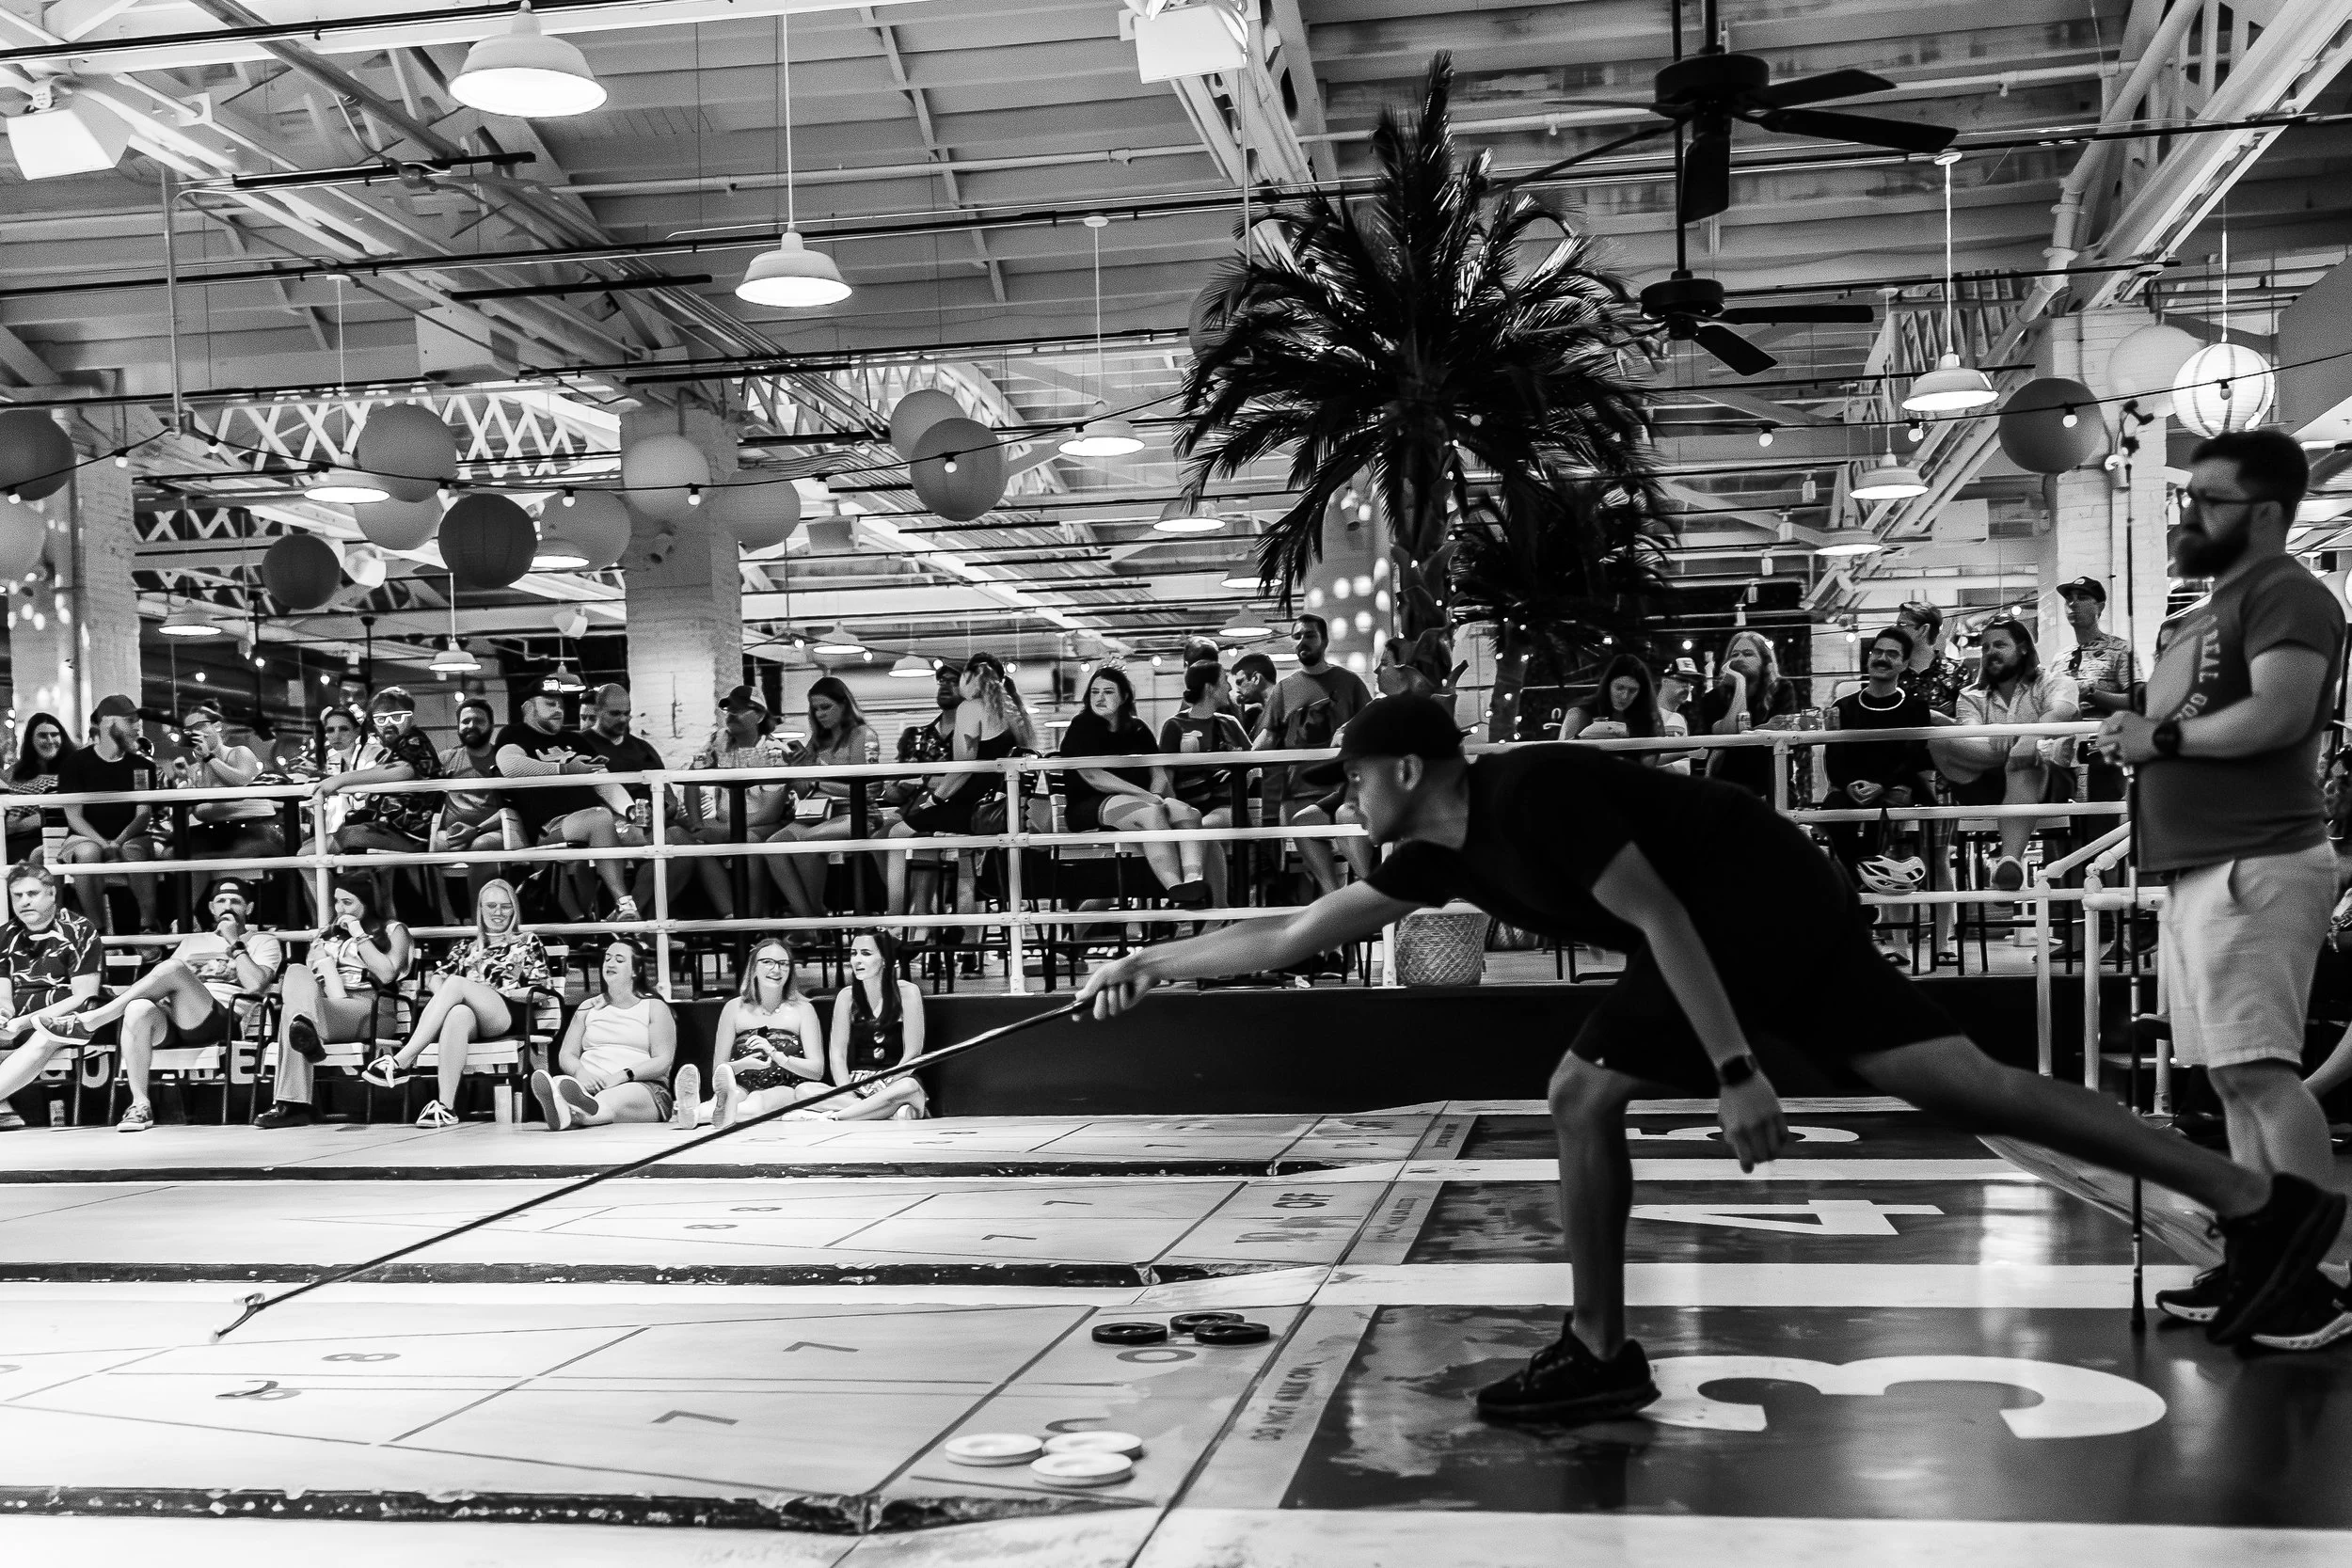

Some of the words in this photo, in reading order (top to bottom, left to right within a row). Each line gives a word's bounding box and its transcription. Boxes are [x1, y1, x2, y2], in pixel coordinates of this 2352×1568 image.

[1626, 1125, 1860, 1142] 5
[1272, 1193, 1334, 1208] OFF
[1627, 1199, 1945, 1235] 4
[783, 1341, 859, 1353] 7
[321, 1353, 401, 1362] 8
[1638, 1355, 2167, 1439] 3
[650, 1410, 739, 1426] 7
[1261, 1405, 1298, 1424] NOT
